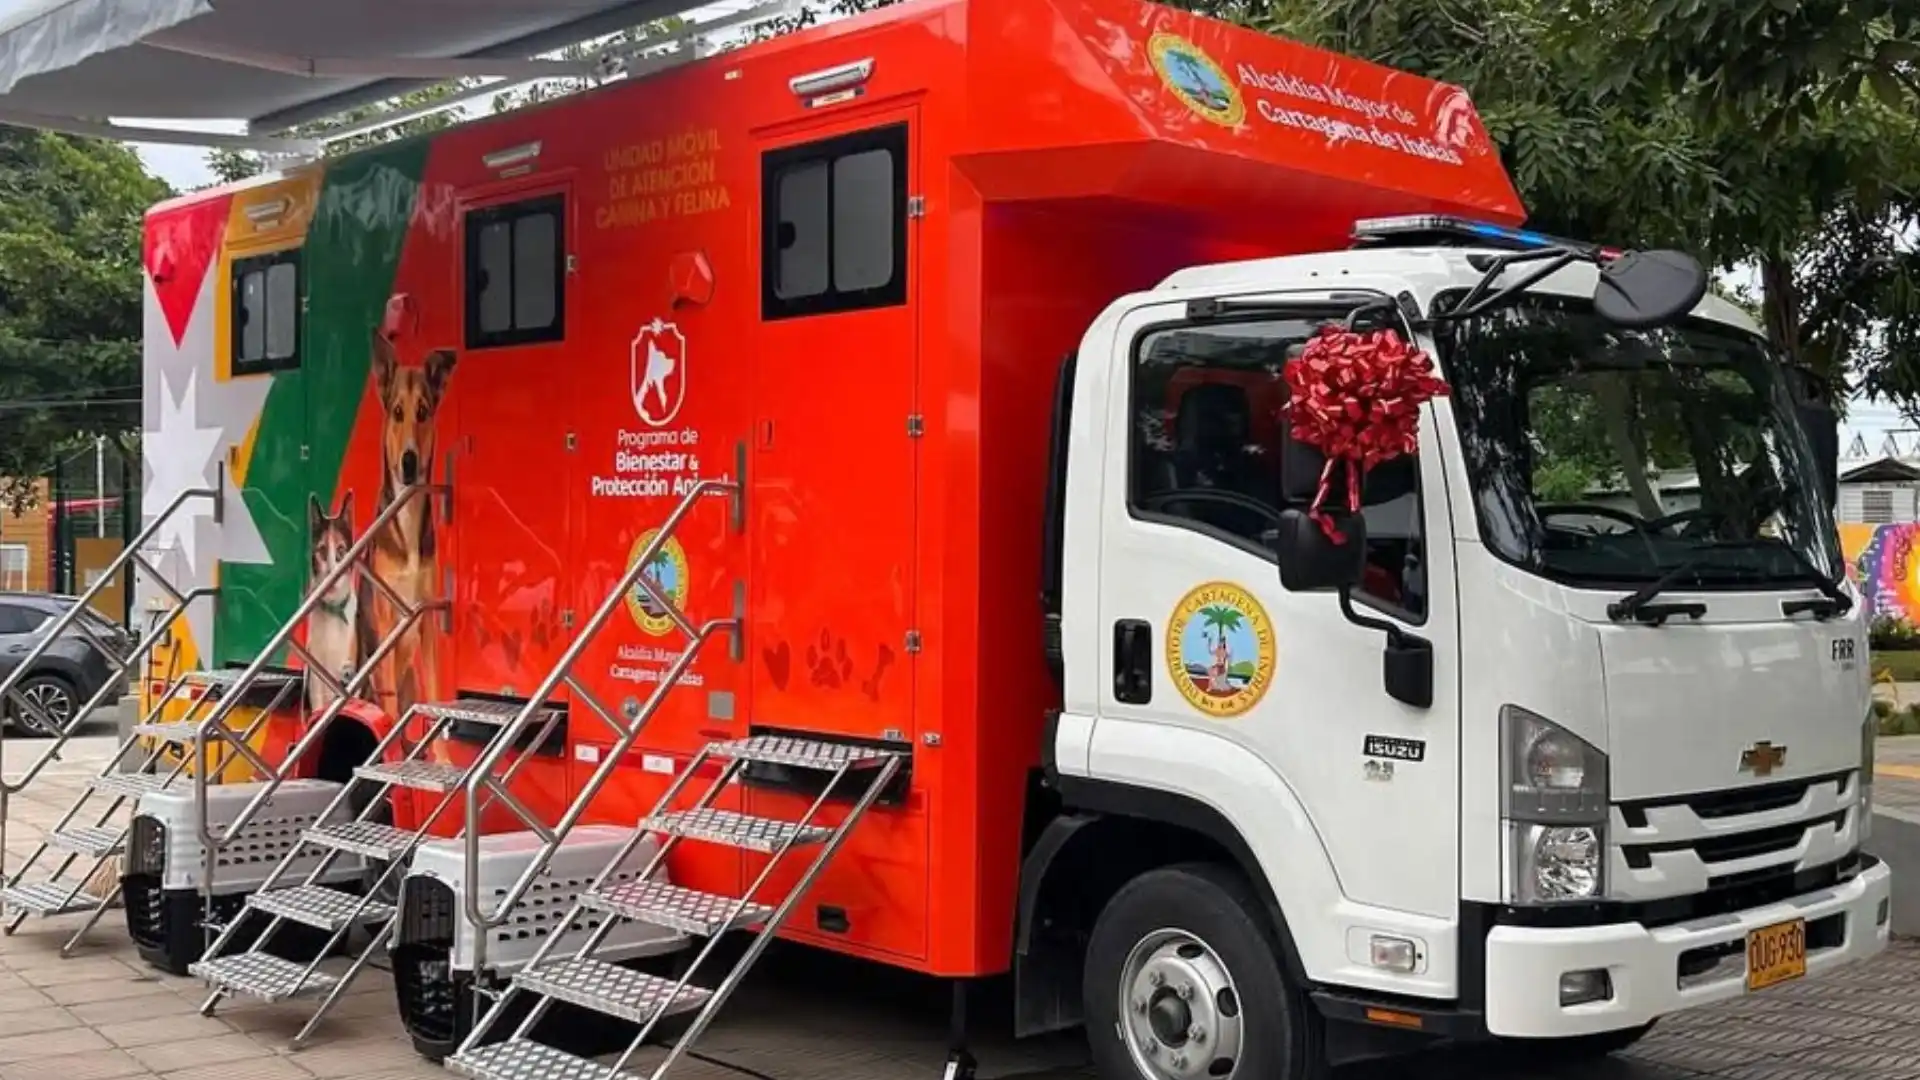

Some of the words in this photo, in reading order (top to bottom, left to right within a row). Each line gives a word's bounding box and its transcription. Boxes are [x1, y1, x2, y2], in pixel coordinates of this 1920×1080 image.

[1321, 84, 1393, 121] Mayor
[1391, 101, 1418, 126] de
[1256, 99, 1372, 145] Cartagena
[1394, 131, 1464, 166] Indias
[604, 139, 663, 171] UNIDAD
[609, 174, 627, 199] DE
[595, 199, 656, 229] CANINA
[659, 196, 671, 219] Y
[674, 185, 731, 216] FELINA
[617, 429, 678, 449] Programa
[680, 427, 699, 444] de
[616, 449, 687, 473] Bienestar
[688, 454, 699, 470] &
[591, 473, 669, 496] Protección
[1832, 638, 1855, 661] FRR
[1369, 742, 1420, 758] ISUZU
